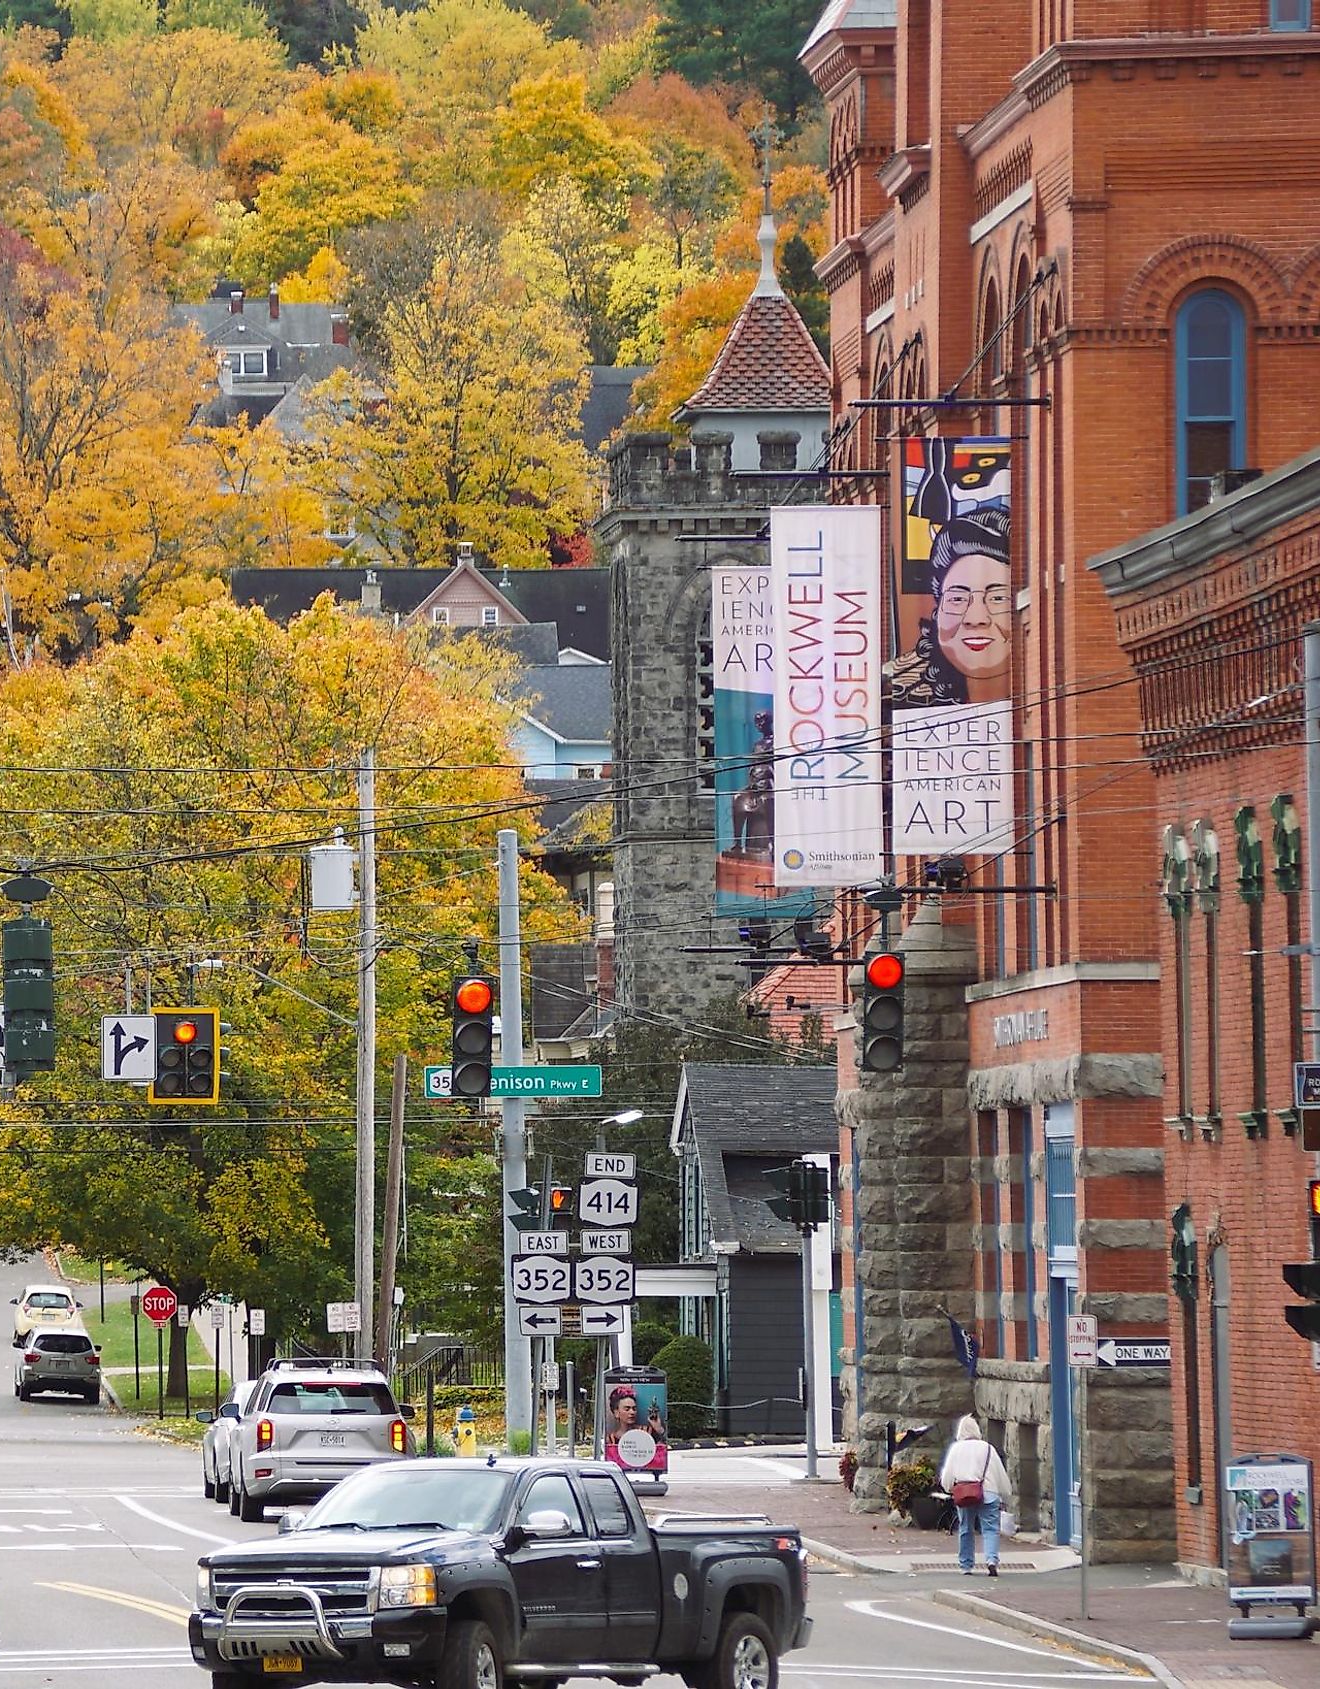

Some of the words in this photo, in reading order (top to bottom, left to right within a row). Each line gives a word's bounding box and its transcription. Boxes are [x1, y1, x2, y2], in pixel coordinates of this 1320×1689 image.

[722, 601, 773, 619] IEN
[721, 624, 773, 636] AMERI
[787, 530, 825, 779] ROCKWELL
[833, 591, 868, 779] MUSEUM
[905, 720, 1000, 742] EXPER
[905, 750, 1000, 771] IENCE
[904, 779, 1001, 791] AMERICAN
[791, 786, 828, 800] THE
[905, 800, 1000, 834] ART
[809, 851, 875, 861] Smithsonian
[432, 1076, 452, 1090] 35
[550, 1079, 577, 1090] Pkwy
[582, 1079, 589, 1088] E
[594, 1158, 626, 1172] END
[586, 1191, 630, 1214] 414
[527, 1236, 559, 1250] EAST
[588, 1235, 622, 1249] WEST
[517, 1268, 566, 1291] 352
[579, 1268, 630, 1291] 352
[144, 1297, 175, 1311] STOP
[1076, 1321, 1088, 1334] NO
[1115, 1347, 1140, 1359] ONE
[1143, 1347, 1169, 1359] WAY
